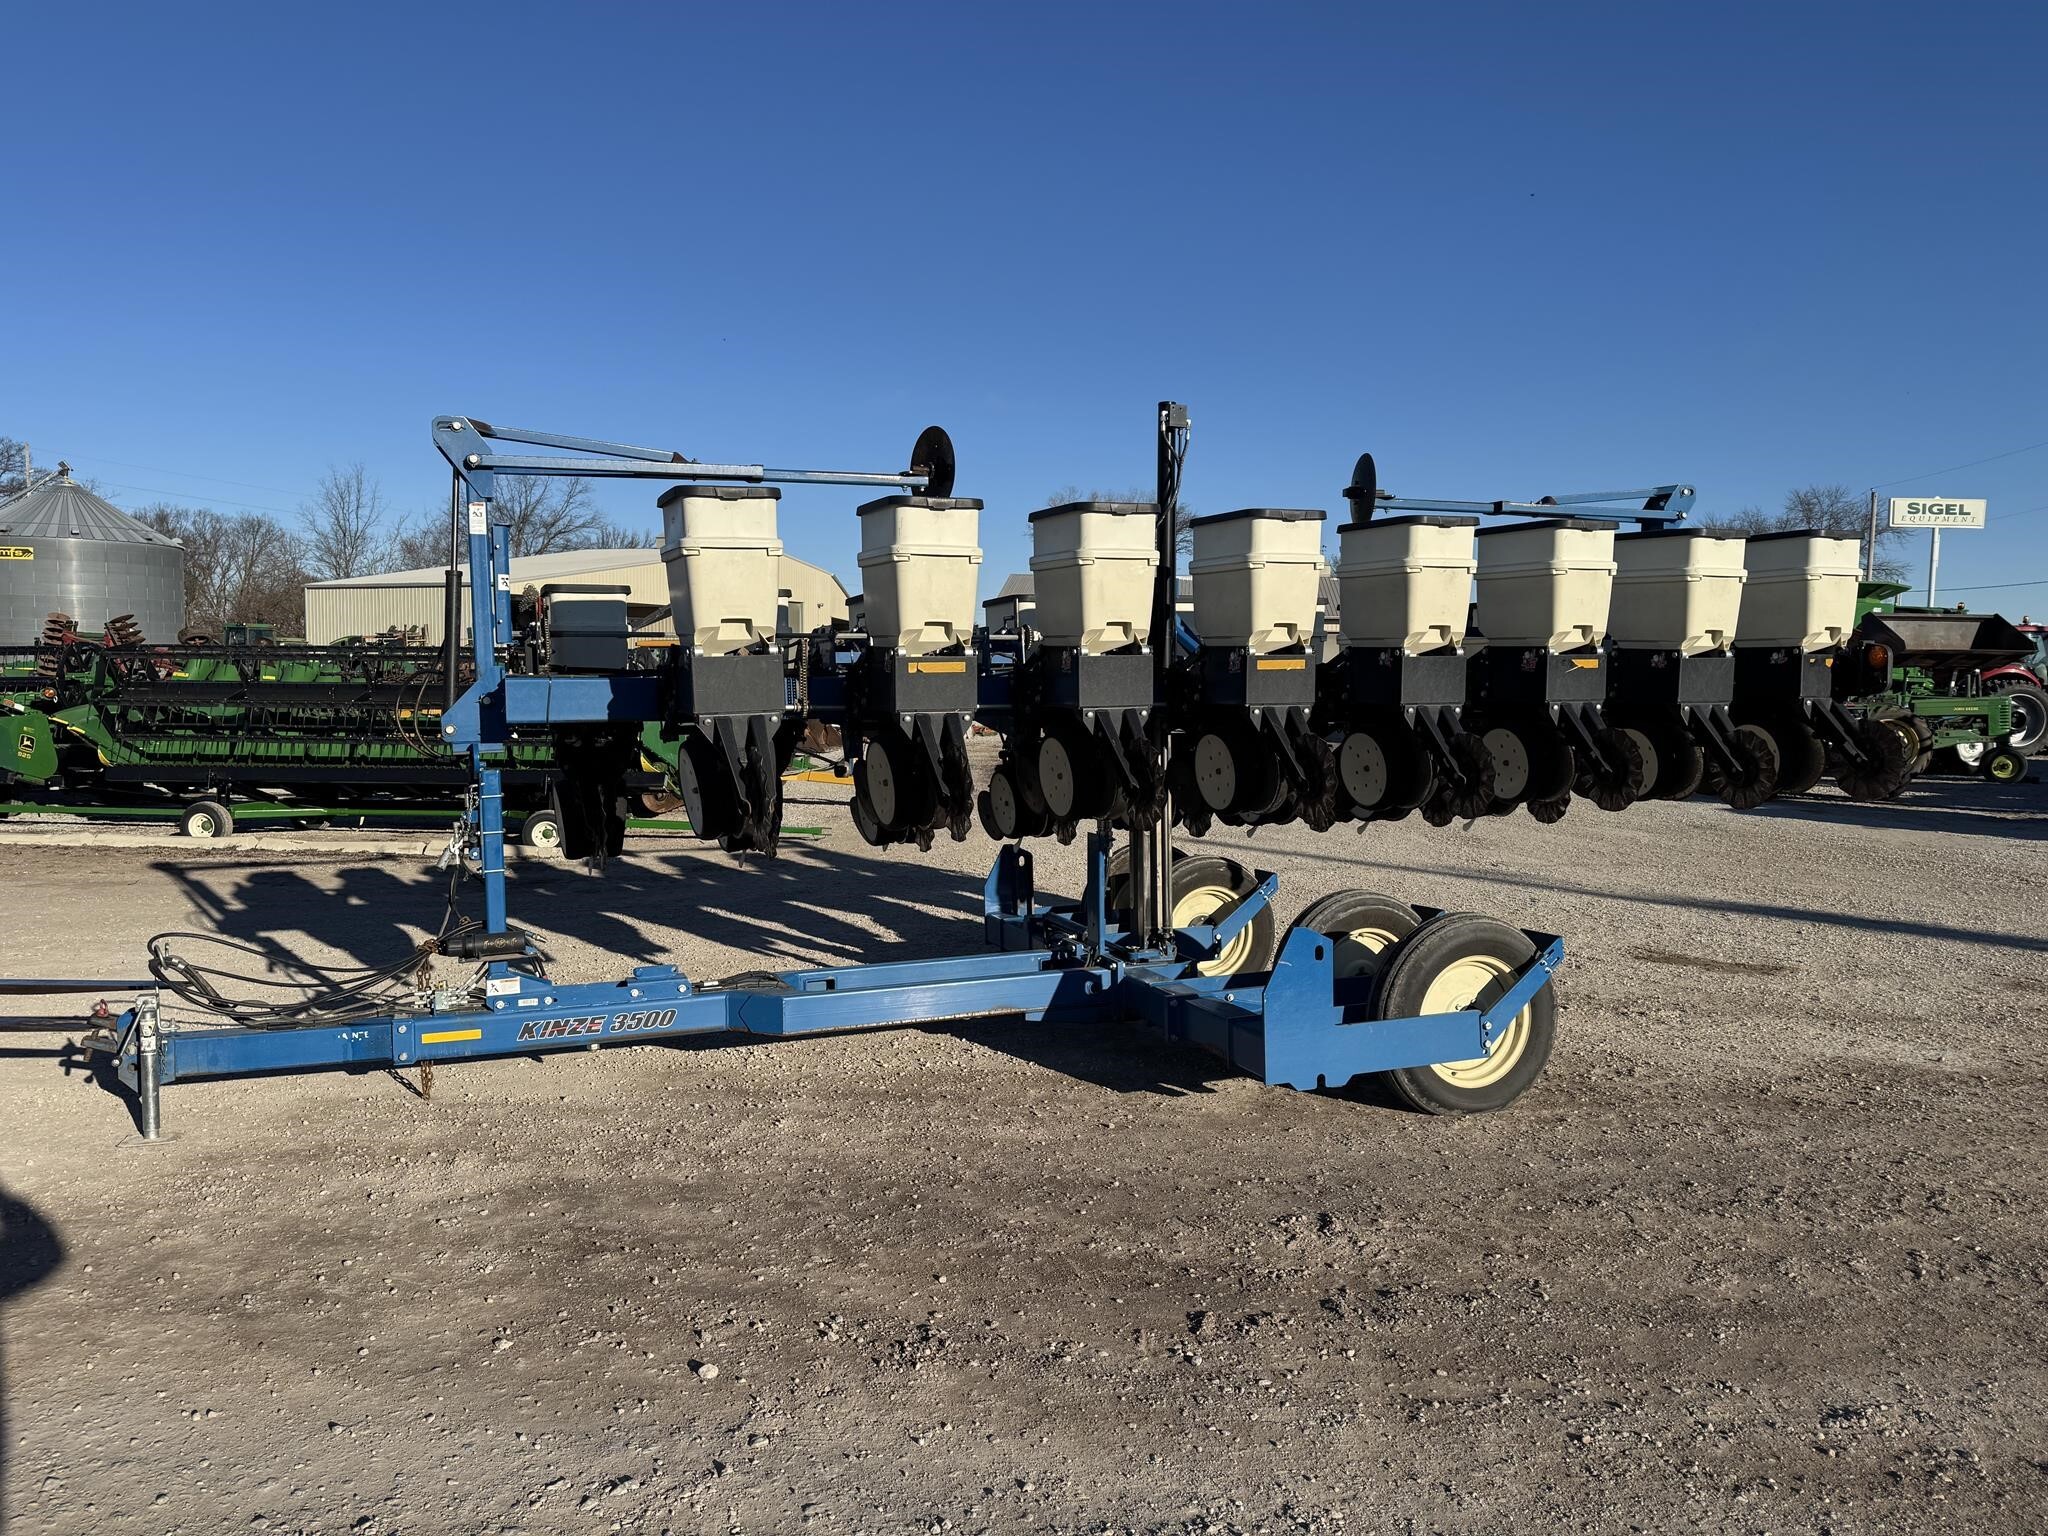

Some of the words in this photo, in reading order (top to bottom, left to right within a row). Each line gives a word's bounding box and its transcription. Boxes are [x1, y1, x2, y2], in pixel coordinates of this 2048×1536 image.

[1907, 502, 1971, 516] SIGEL
[1901, 515, 1976, 523] EQUIPMENT
[517, 1015, 608, 1041] KINZE
[609, 1008, 677, 1033] 3500
